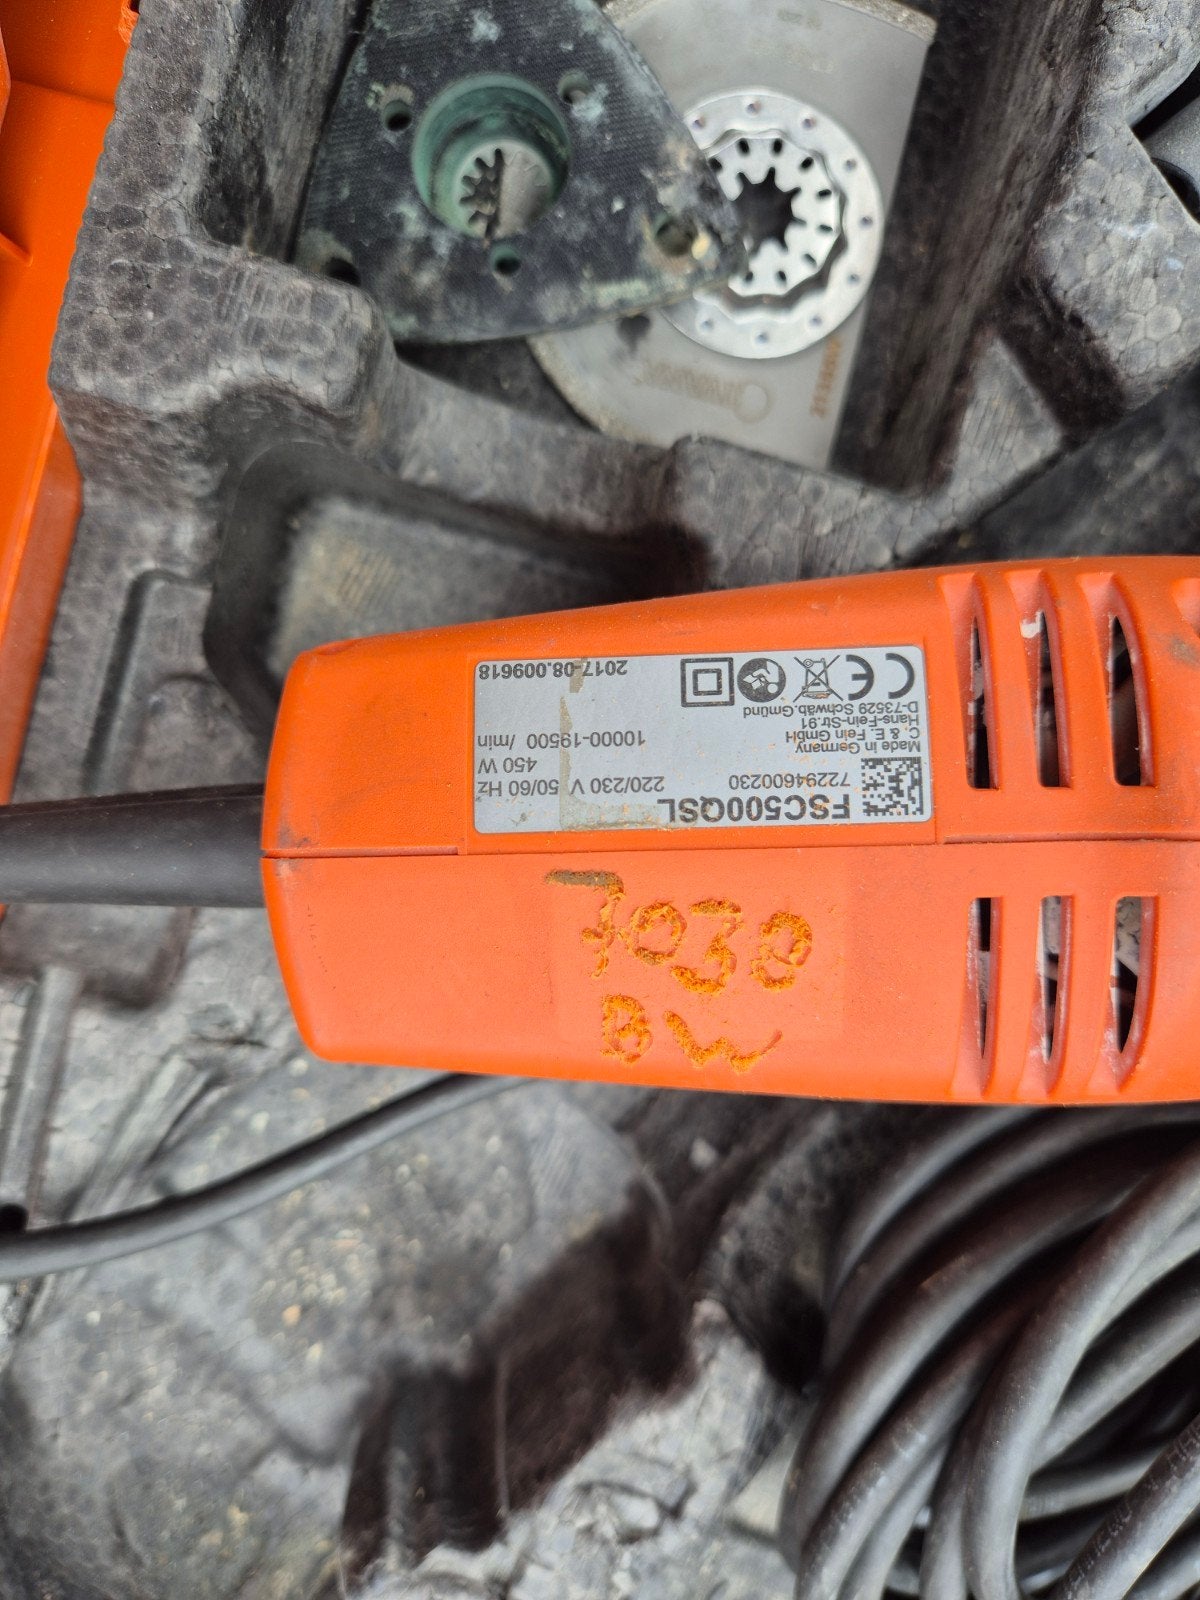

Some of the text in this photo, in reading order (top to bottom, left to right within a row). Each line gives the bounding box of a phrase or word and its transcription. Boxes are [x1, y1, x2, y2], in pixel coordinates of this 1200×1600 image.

[478, 660, 628, 680] 2017-08.009618
[743, 701, 919, 718] D-73529 Schwäb.Gmünd
[801, 714, 919, 729] Hans-Fein-Str.91
[477, 730, 646, 752] 10000-19500 /min
[785, 727, 921, 743] C. & E. Fein GmbH
[795, 740, 921, 755] Made in Germany
[477, 757, 538, 774] 450 W
[477, 776, 665, 797] 220/230 V 50/60 Hz
[728, 772, 851, 790] 72294600230
[657, 793, 850, 823] FSC500QSL
